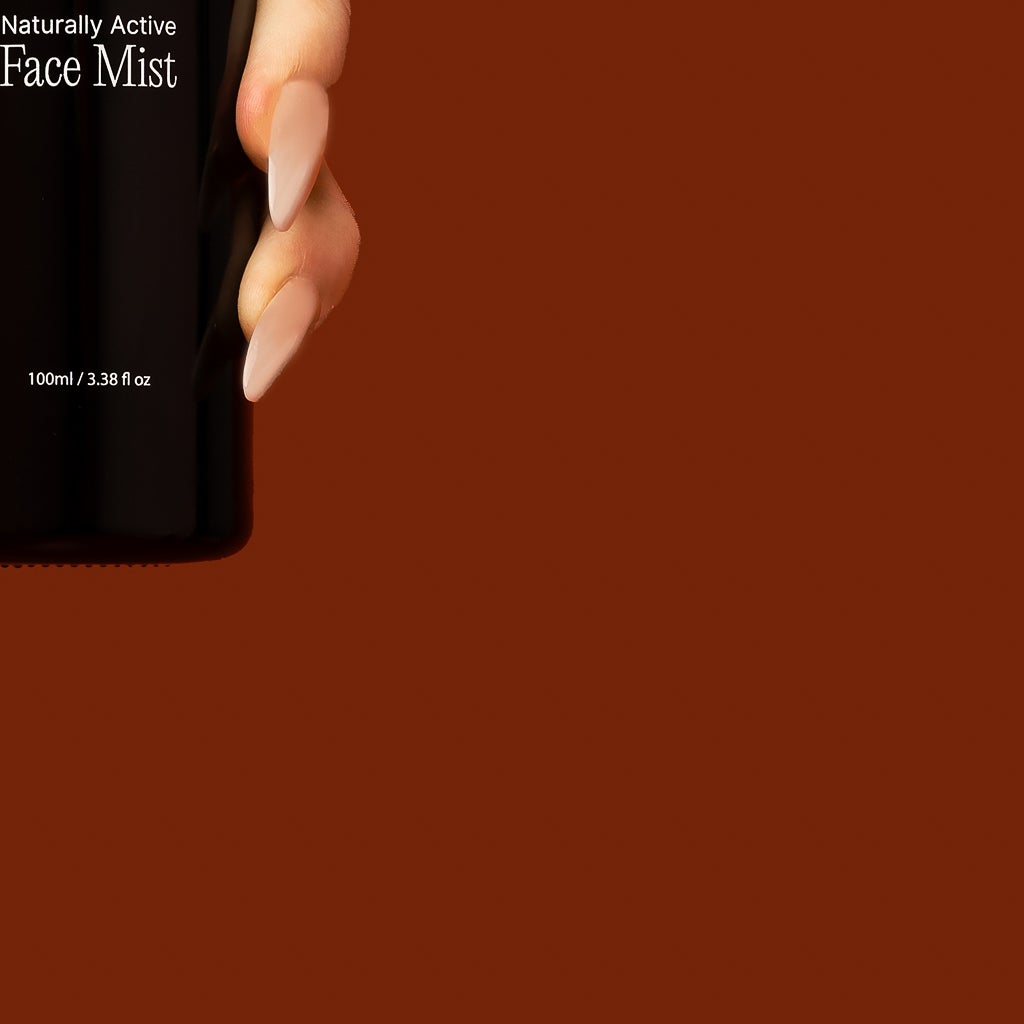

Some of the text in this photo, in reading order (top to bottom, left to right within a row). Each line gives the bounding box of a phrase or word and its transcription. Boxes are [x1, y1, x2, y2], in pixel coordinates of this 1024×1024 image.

[1, 14, 177, 39] Naturally Active
[0, 43, 178, 89] Face Mist
[28, 371, 151, 386] 100ml / 3.38 fl oz
